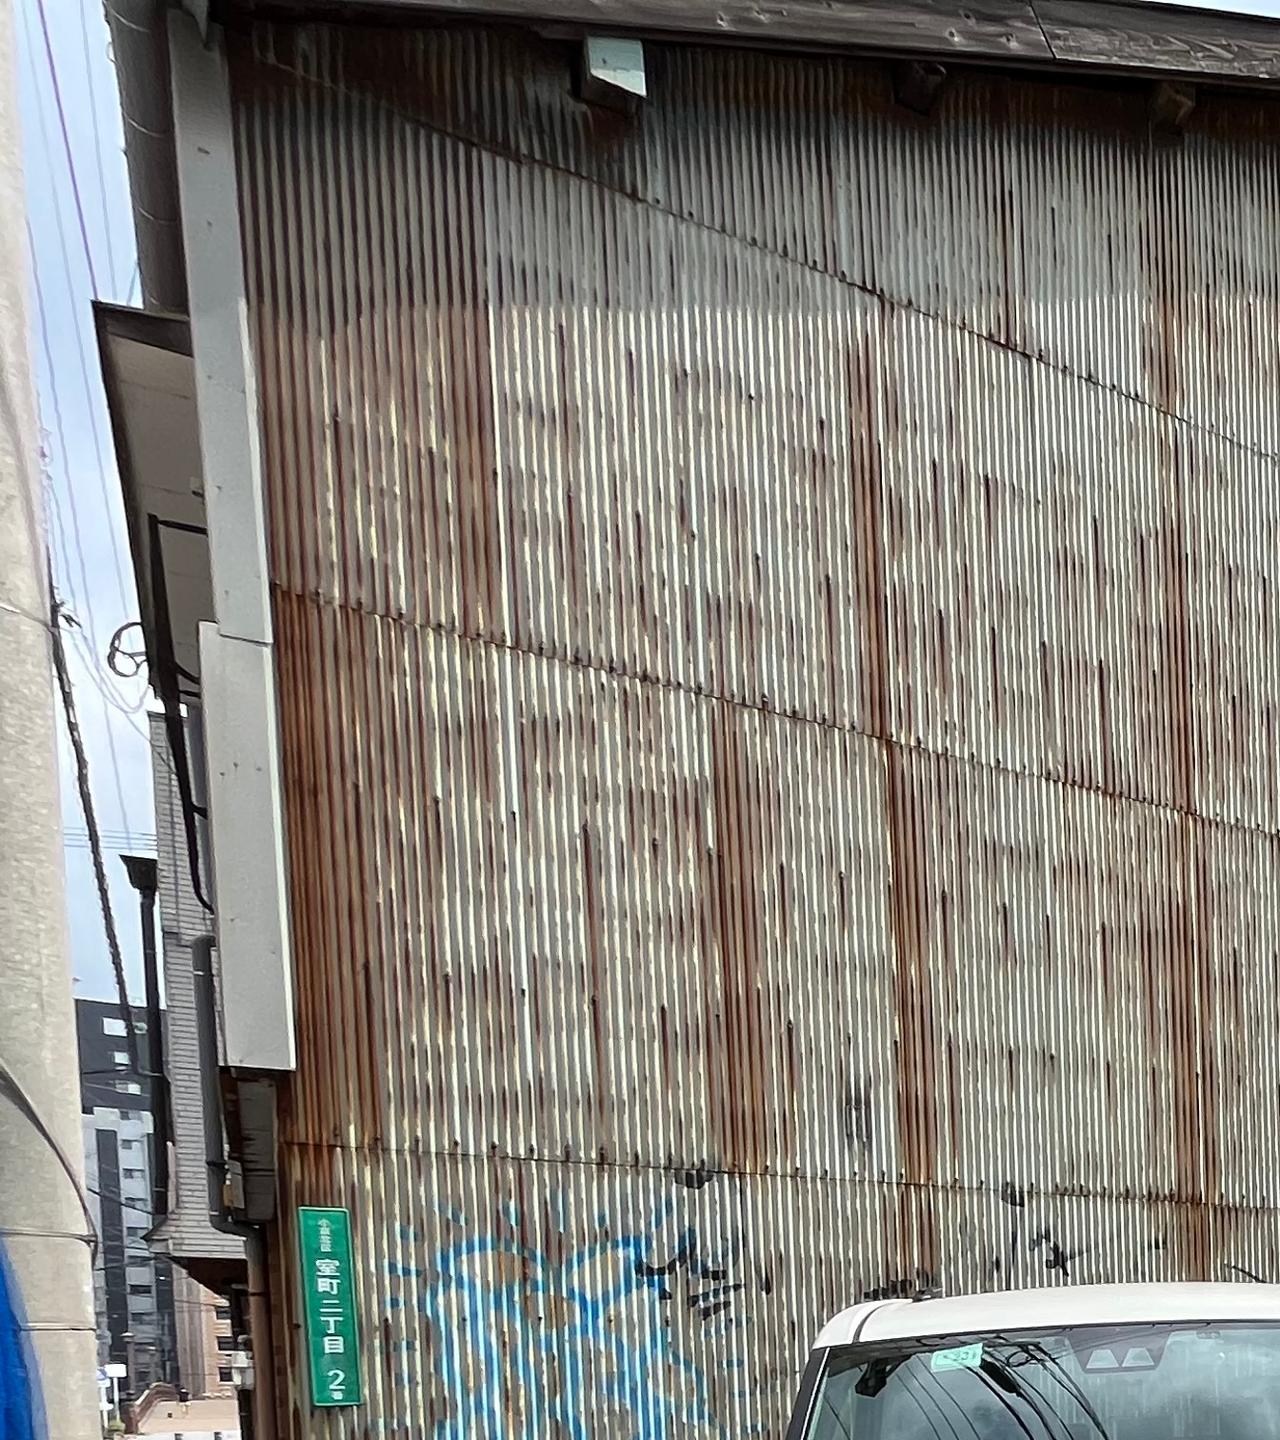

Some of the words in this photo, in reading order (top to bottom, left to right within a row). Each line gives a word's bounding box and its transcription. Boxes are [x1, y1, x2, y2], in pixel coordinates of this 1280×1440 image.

[315, 1258, 345, 1354] 室町二丁目
